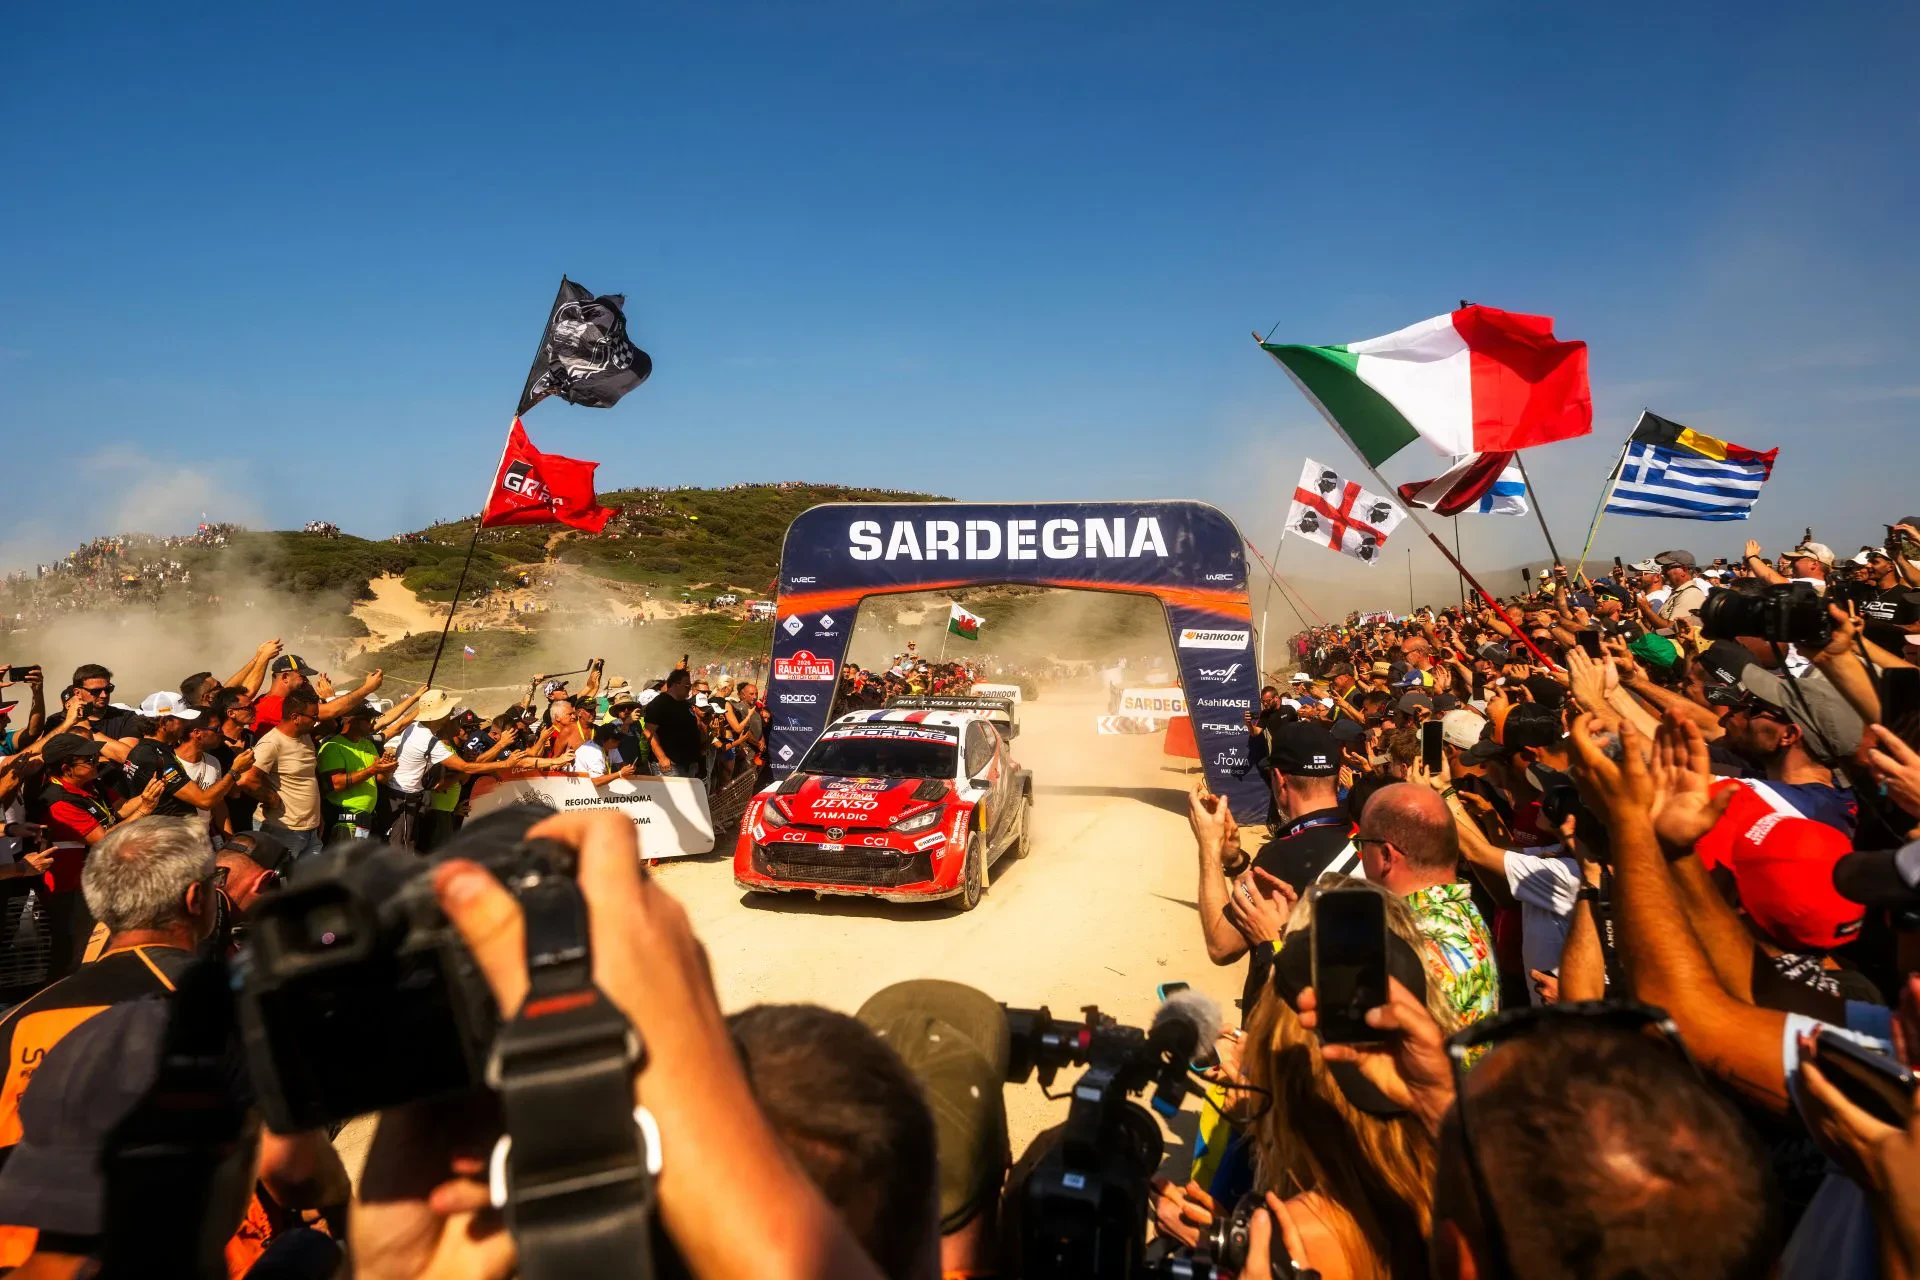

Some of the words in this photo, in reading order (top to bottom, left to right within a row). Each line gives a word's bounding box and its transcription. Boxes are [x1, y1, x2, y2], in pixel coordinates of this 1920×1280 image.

[504, 472, 540, 497] GR
[848, 517, 1169, 561] SARDEGNA
[778, 664, 802, 675] RALLY
[804, 665, 831, 675] ITALIA
[780, 693, 817, 704] sparco
[850, 729, 948, 741] FORUM8
[565, 797, 602, 806] REGIONE
[811, 800, 879, 810] DENSO
[813, 811, 868, 820] TAMADIC
[783, 833, 807, 841] CCI
[863, 836, 889, 846] CCI
